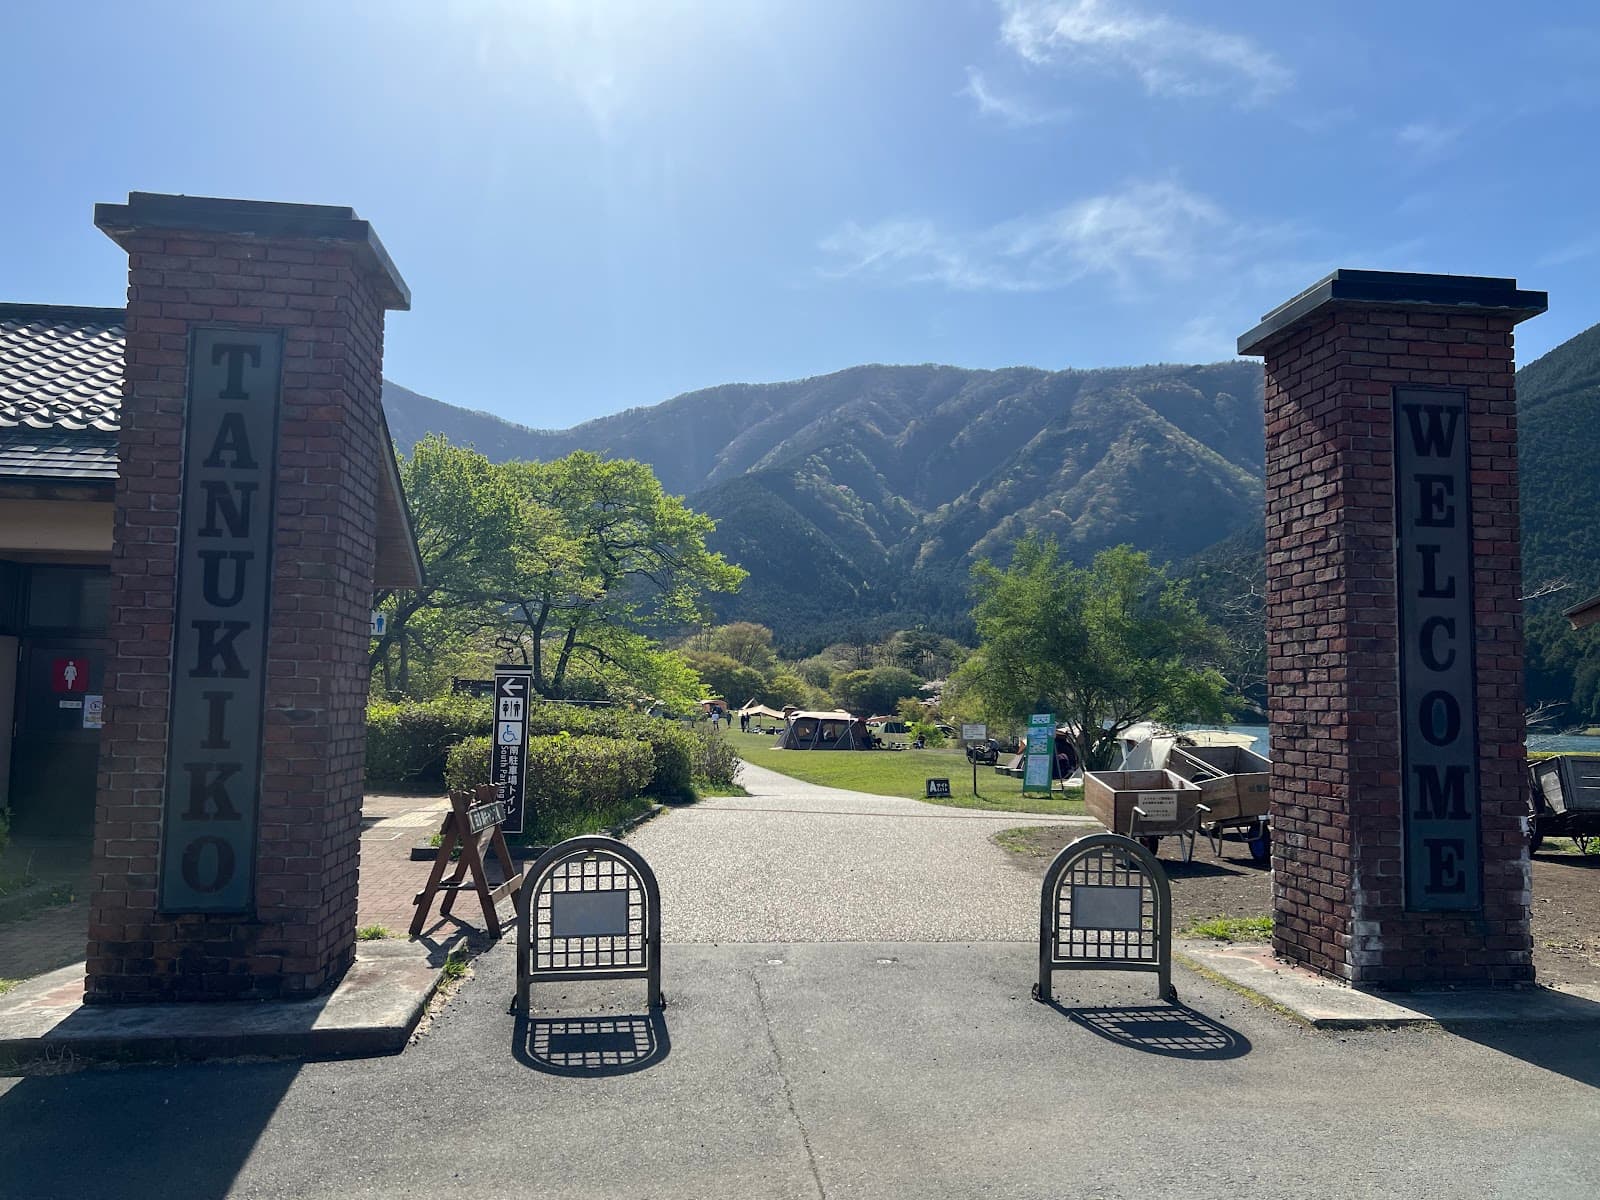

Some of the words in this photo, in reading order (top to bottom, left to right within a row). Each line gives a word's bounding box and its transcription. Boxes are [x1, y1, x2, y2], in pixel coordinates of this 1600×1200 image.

[181, 343, 261, 893] TANUKIKO
[500, 745, 509, 768] South
[1402, 404, 1471, 894] WELCOME
[507, 745, 519, 814] 南駐車場トイレ
